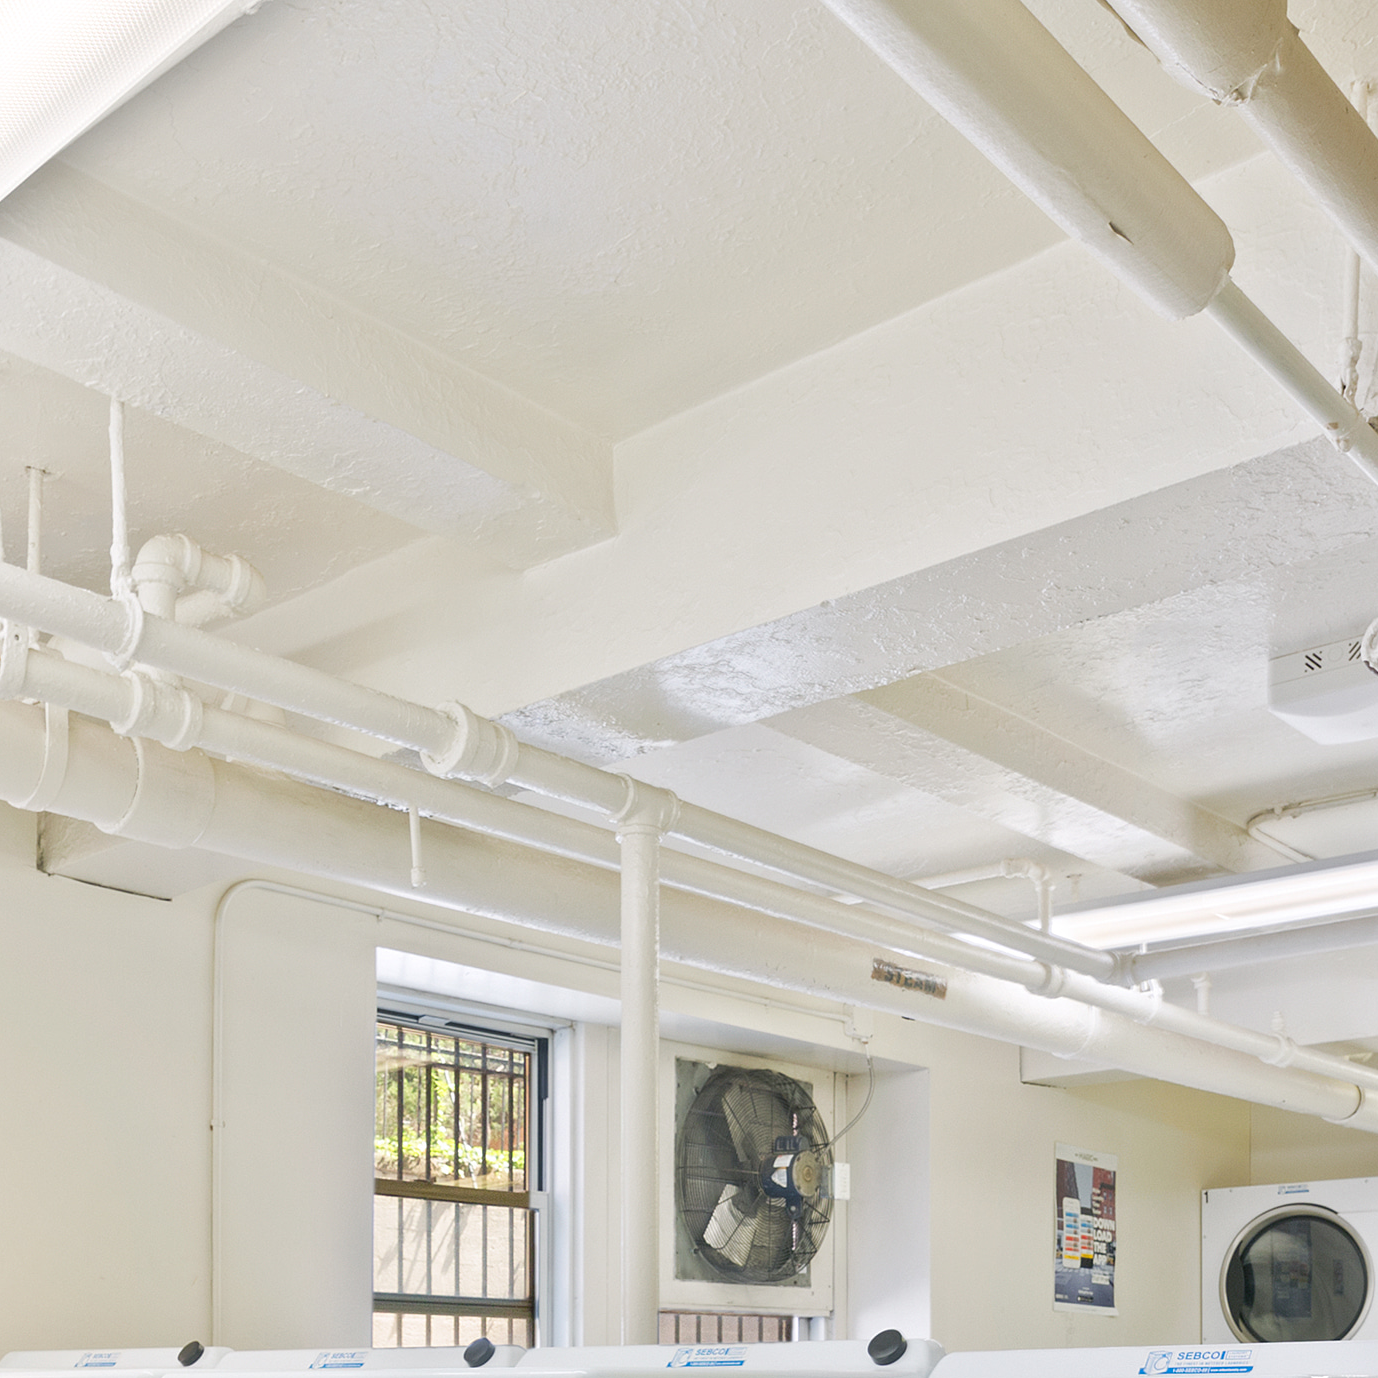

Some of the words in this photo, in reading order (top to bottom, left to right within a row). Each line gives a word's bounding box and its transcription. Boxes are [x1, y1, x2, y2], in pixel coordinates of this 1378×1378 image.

[1204, 1191, 1209, 1204] 1
[1093, 1217, 1115, 1231] DOWN
[1093, 1229, 1112, 1243] LOAD
[695, 1348, 726, 1356] SEBCO
[1177, 1351, 1220, 1360] SEBCO
